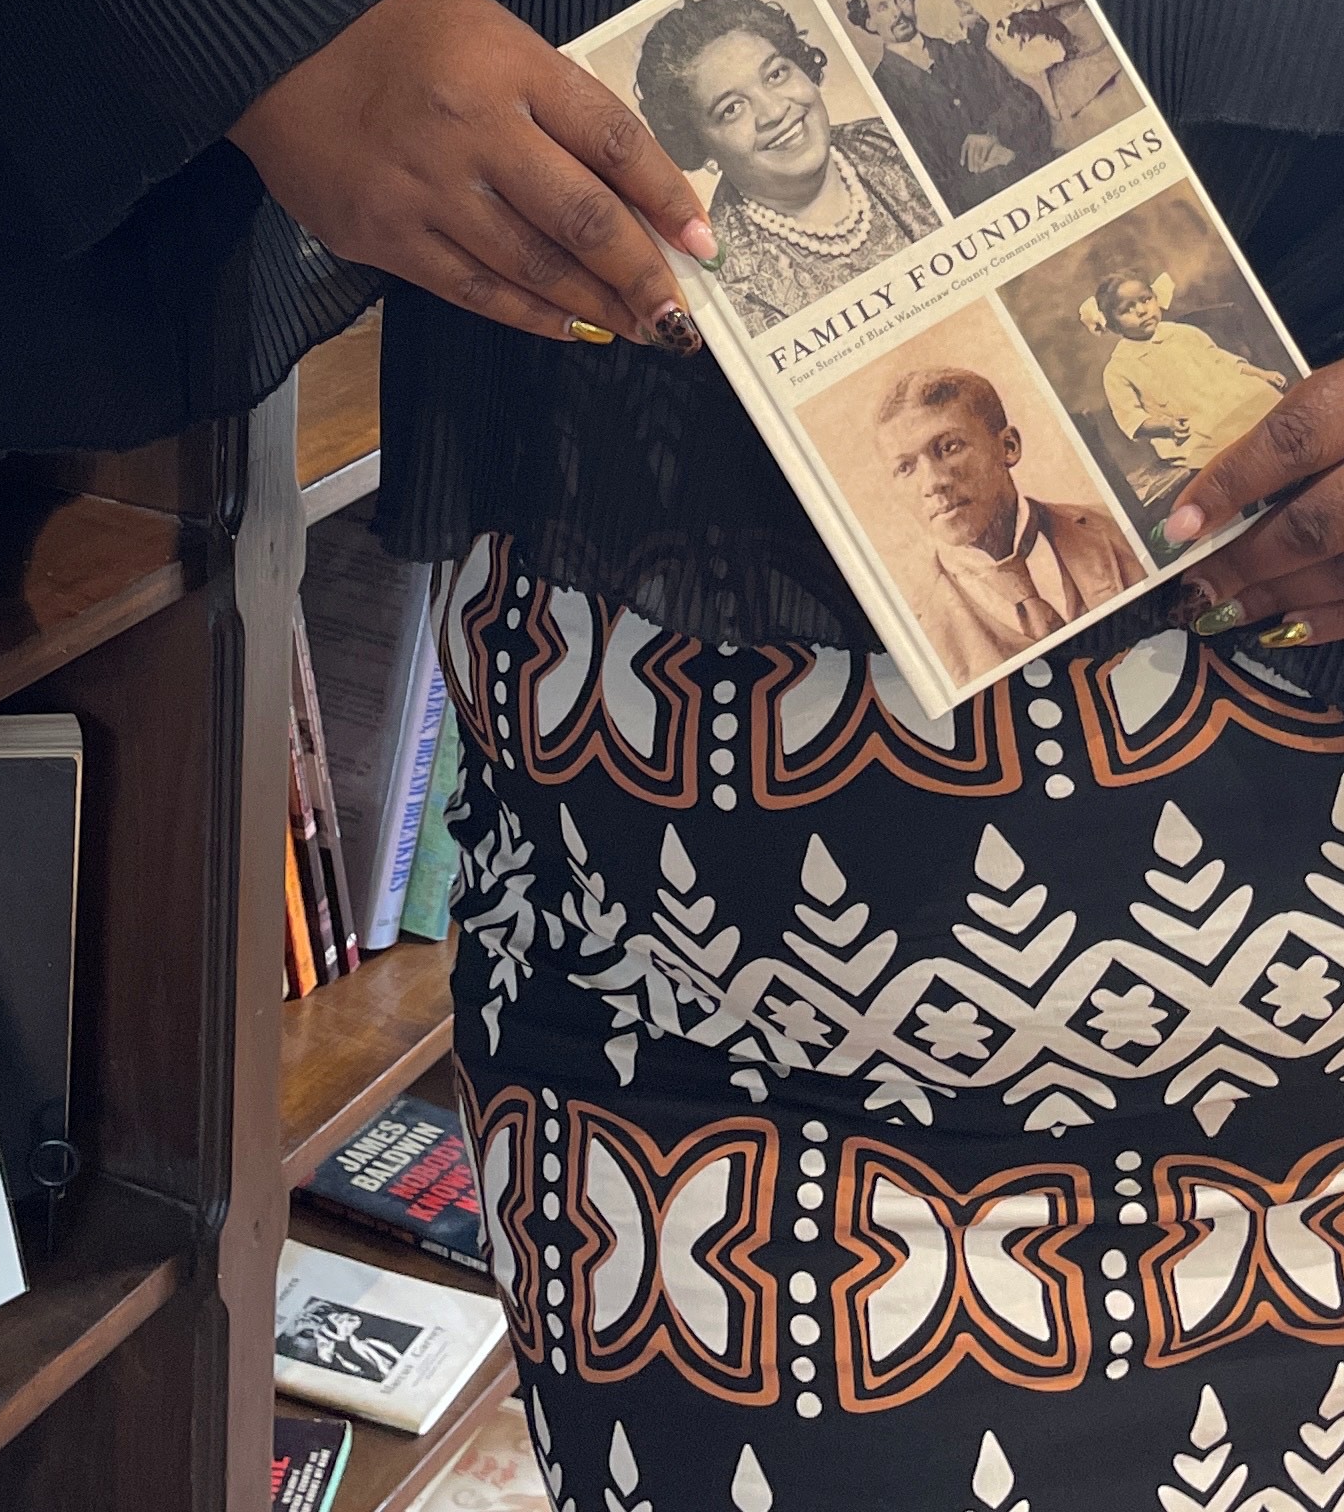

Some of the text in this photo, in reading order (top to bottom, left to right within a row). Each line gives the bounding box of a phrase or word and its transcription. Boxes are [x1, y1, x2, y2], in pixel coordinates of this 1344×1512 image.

[767, 128, 1163, 374] FAMILY FOUNDATIONS
[789, 161, 1167, 387] Four Stories of Black Washtenaw County Community Building, 1850 to 1950
[336, 1119, 408, 1173] JAMES
[350, 1121, 445, 1193] BALDWIN
[387, 1135, 466, 1200] NOBODY
